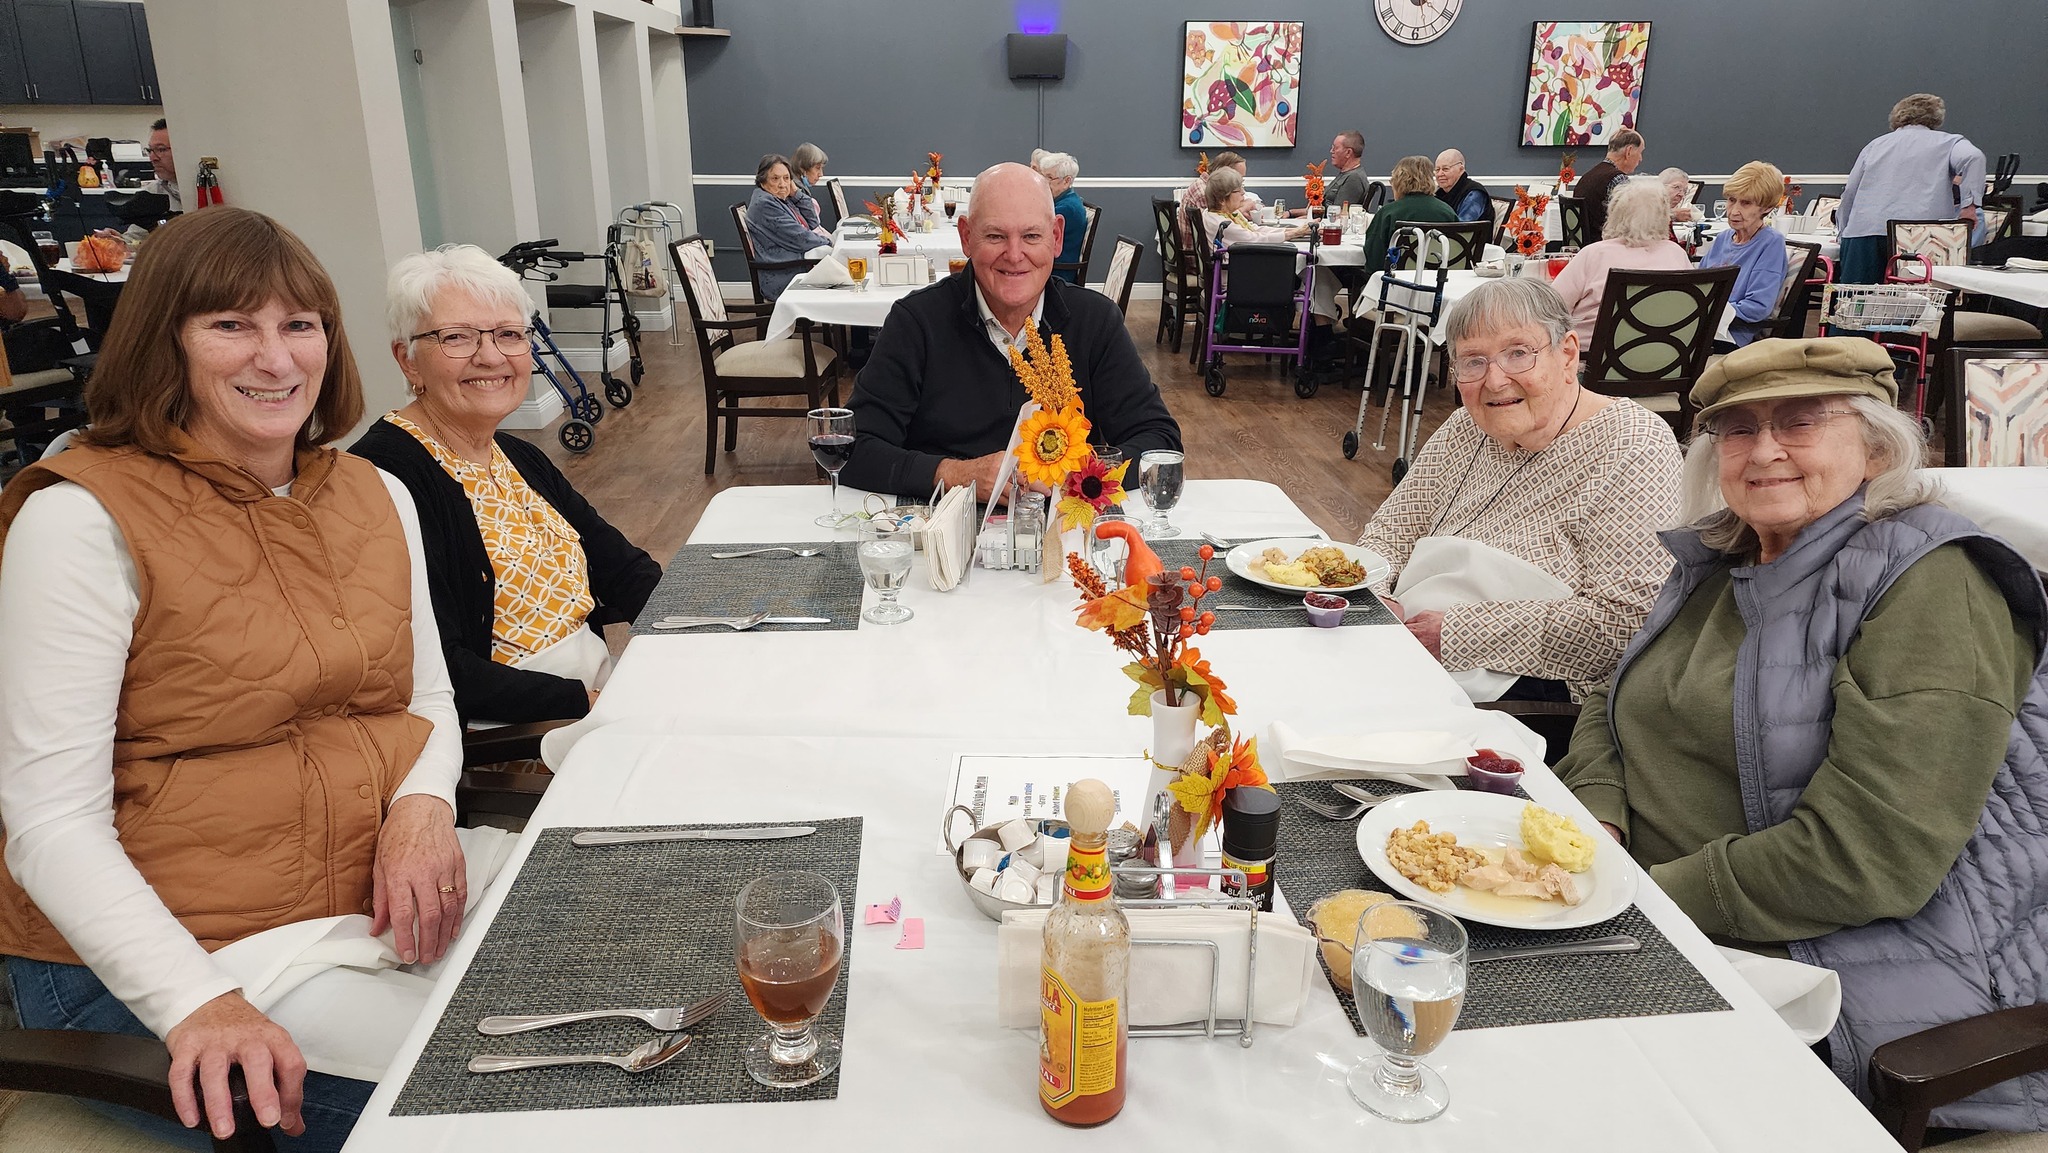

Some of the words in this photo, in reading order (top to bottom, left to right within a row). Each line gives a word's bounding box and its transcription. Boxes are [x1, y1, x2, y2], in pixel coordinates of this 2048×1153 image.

[1411, 27, 1419, 40] 6
[1248, 316, 1267, 324] nova
[974, 776, 987, 790] Menu
[1052, 786, 1060, 801] Potatoes
[1008, 795, 1019, 806] Main
